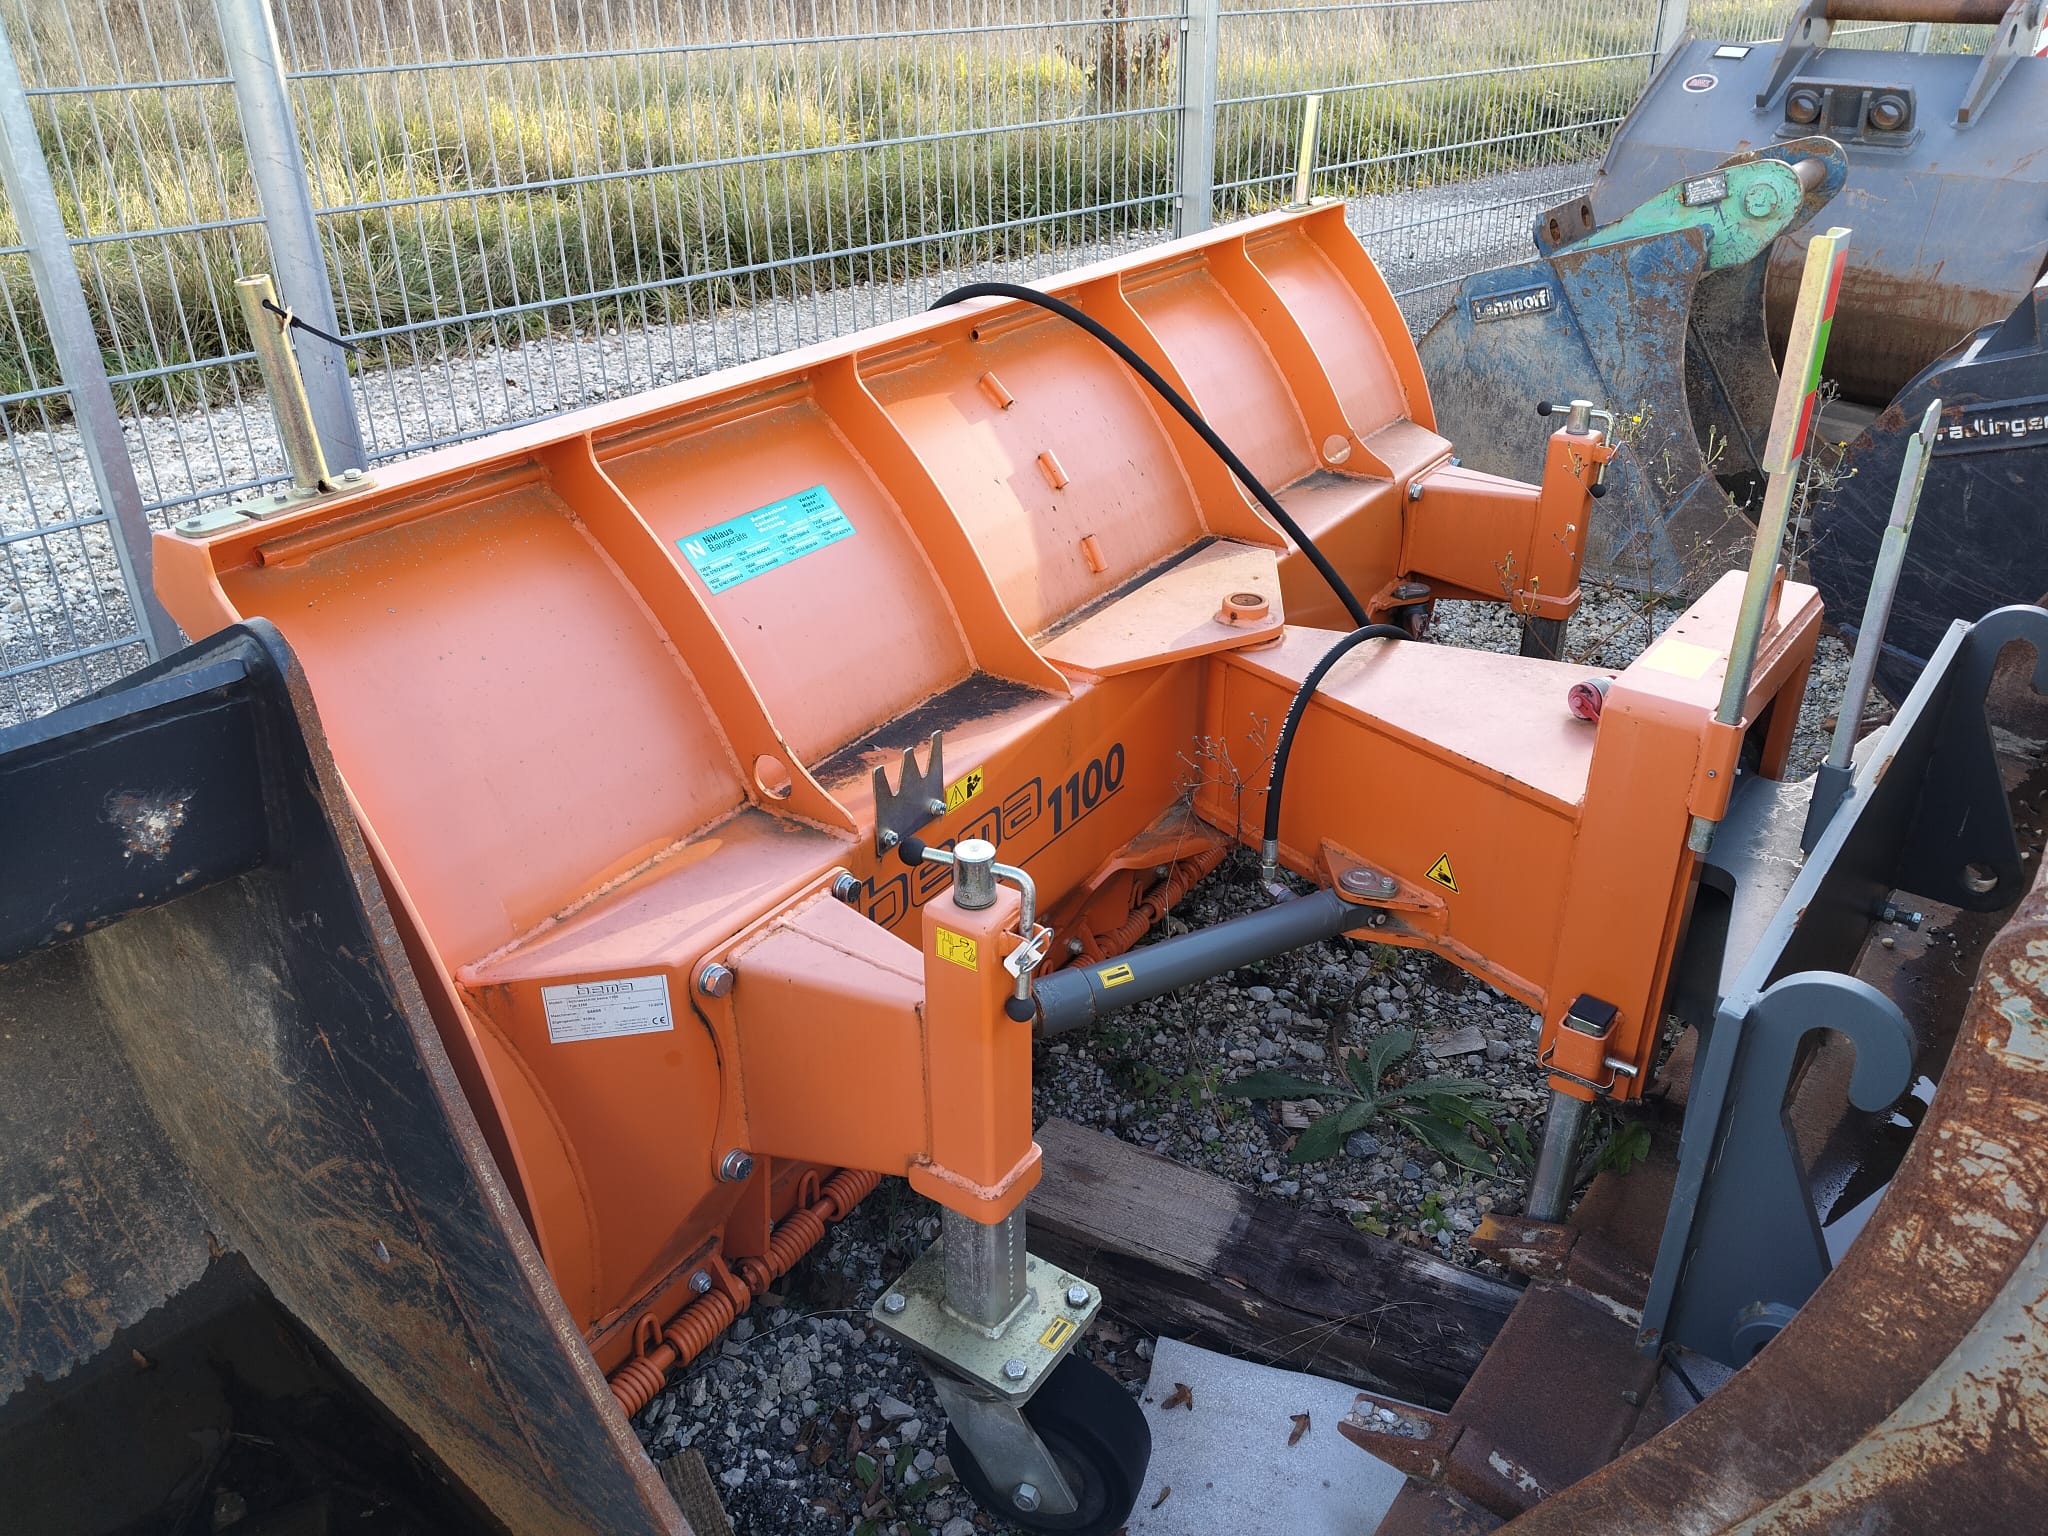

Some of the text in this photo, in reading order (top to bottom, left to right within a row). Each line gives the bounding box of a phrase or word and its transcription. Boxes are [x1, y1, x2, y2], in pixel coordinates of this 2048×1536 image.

[799, 492, 818, 503] Verkauf
[801, 499, 816, 508] Miete
[805, 502, 824, 513] Service
[701, 526, 734, 544] Niklaus
[707, 530, 748, 553] Baugeräte
[684, 539, 707, 559] N
[1047, 742, 1125, 836] 1100
[577, 982, 633, 995] bema
